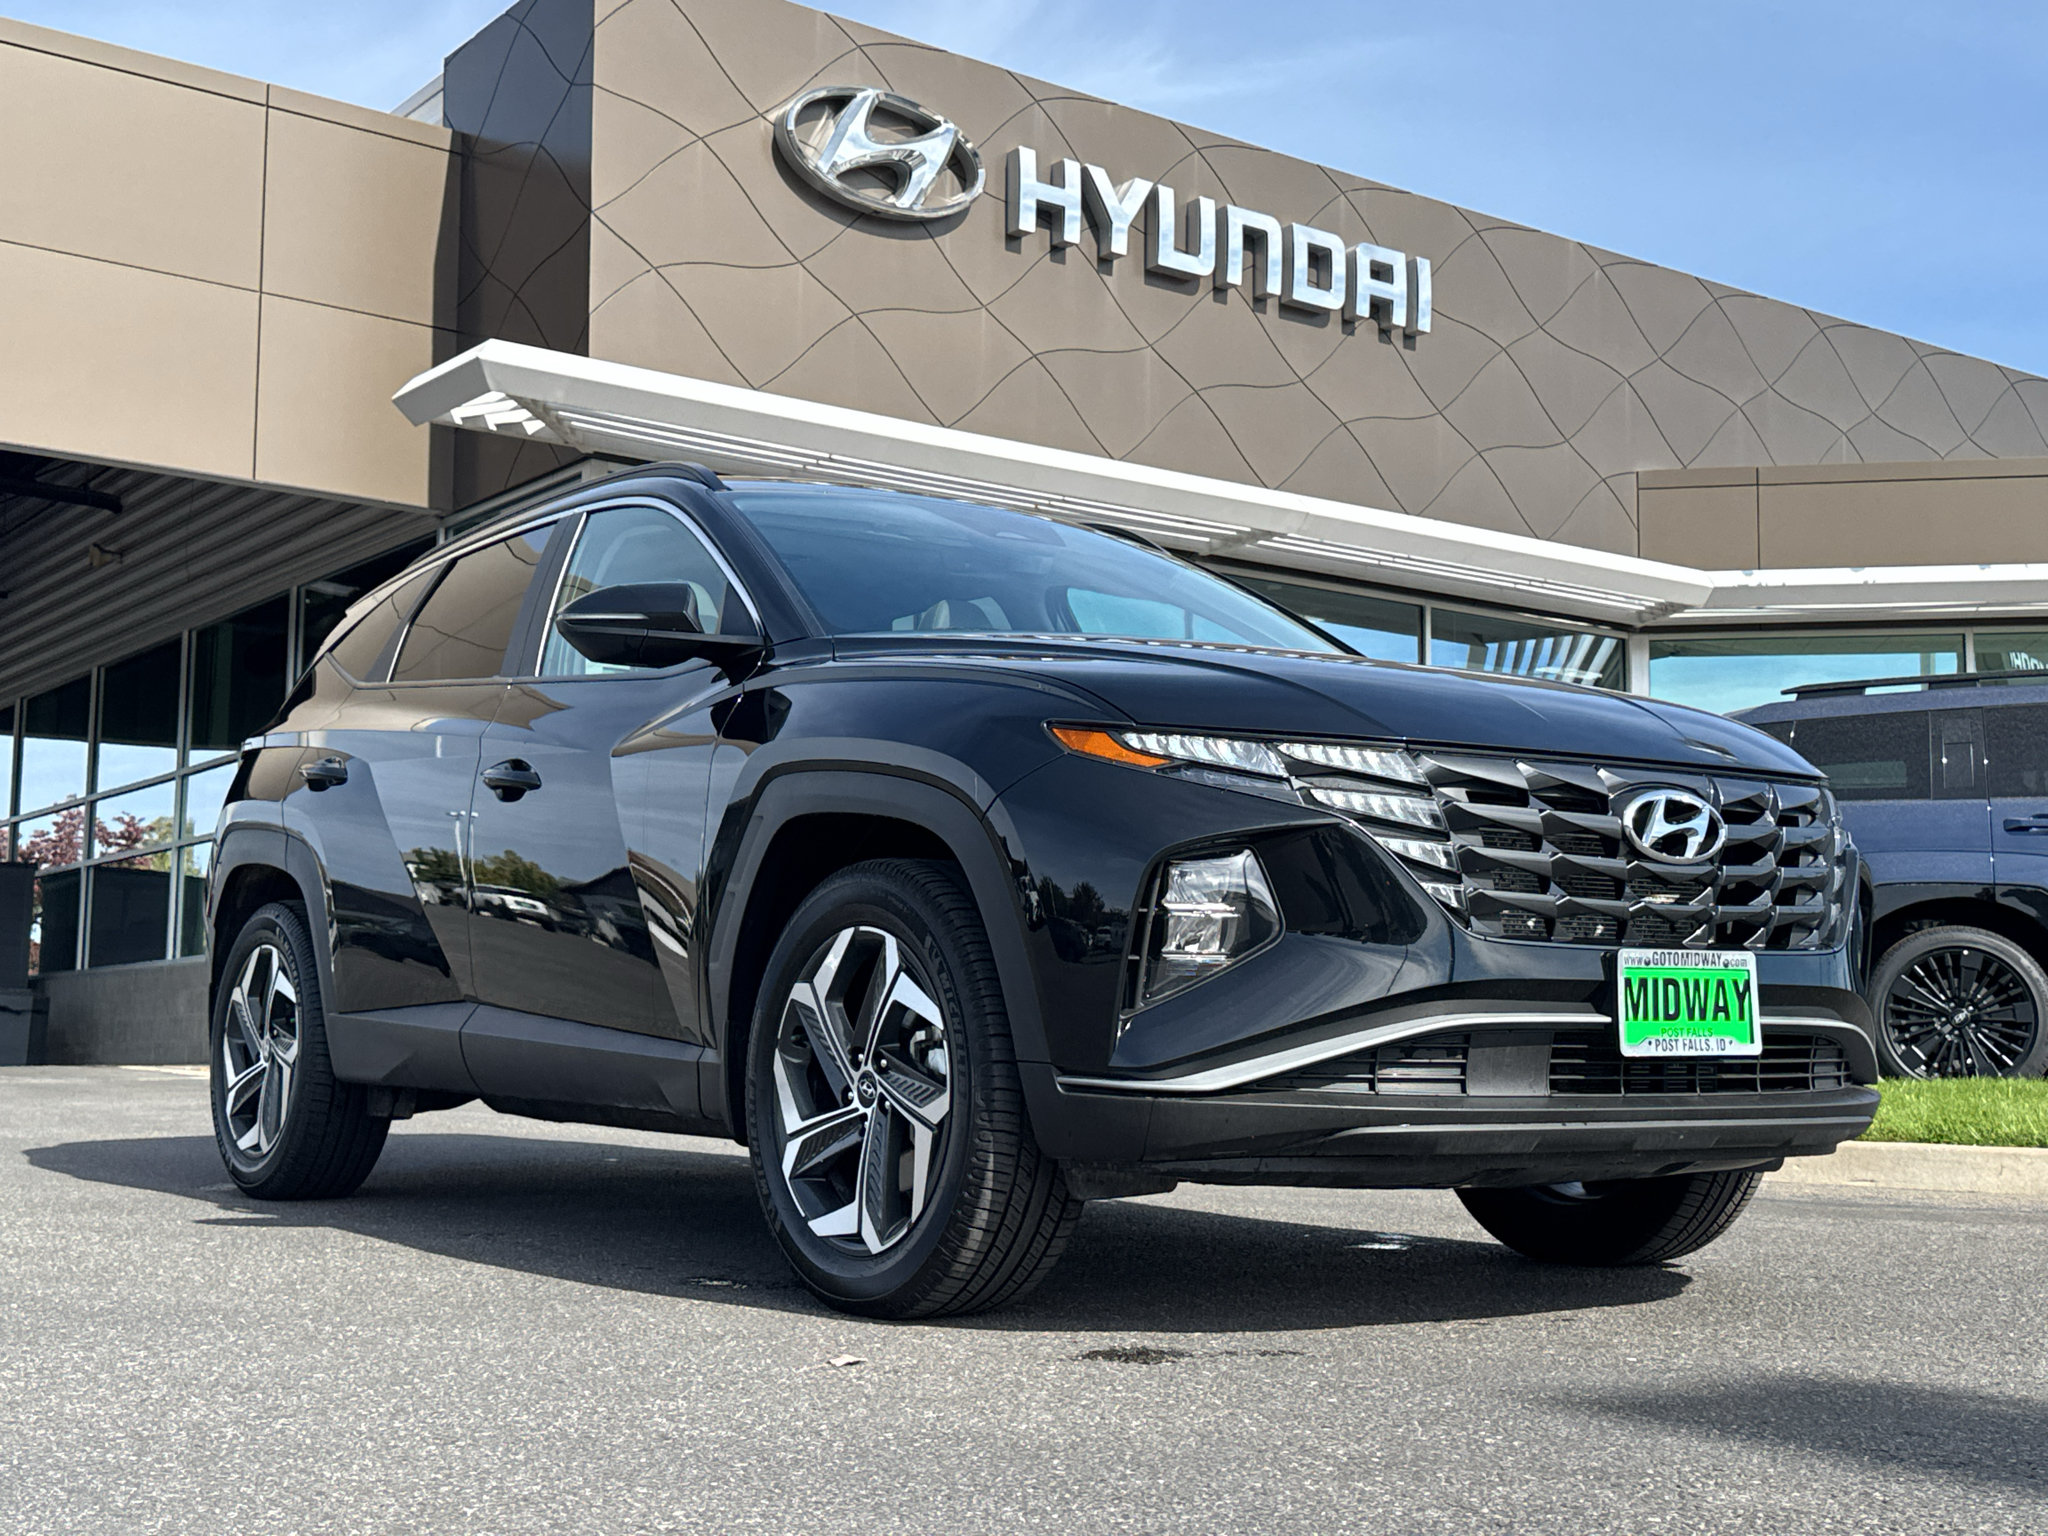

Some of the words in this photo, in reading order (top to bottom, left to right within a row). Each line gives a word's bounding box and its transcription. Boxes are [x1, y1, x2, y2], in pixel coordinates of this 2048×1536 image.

[1007, 145, 1431, 335] HYUNDAI
[1624, 977, 1750, 1022] MIDWAY
[1655, 1039, 1679, 1052] POST
[1716, 1039, 1726, 1052] ID
[1661, 1027, 1684, 1037] POST
[1687, 1028, 1713, 1037] FALLS
